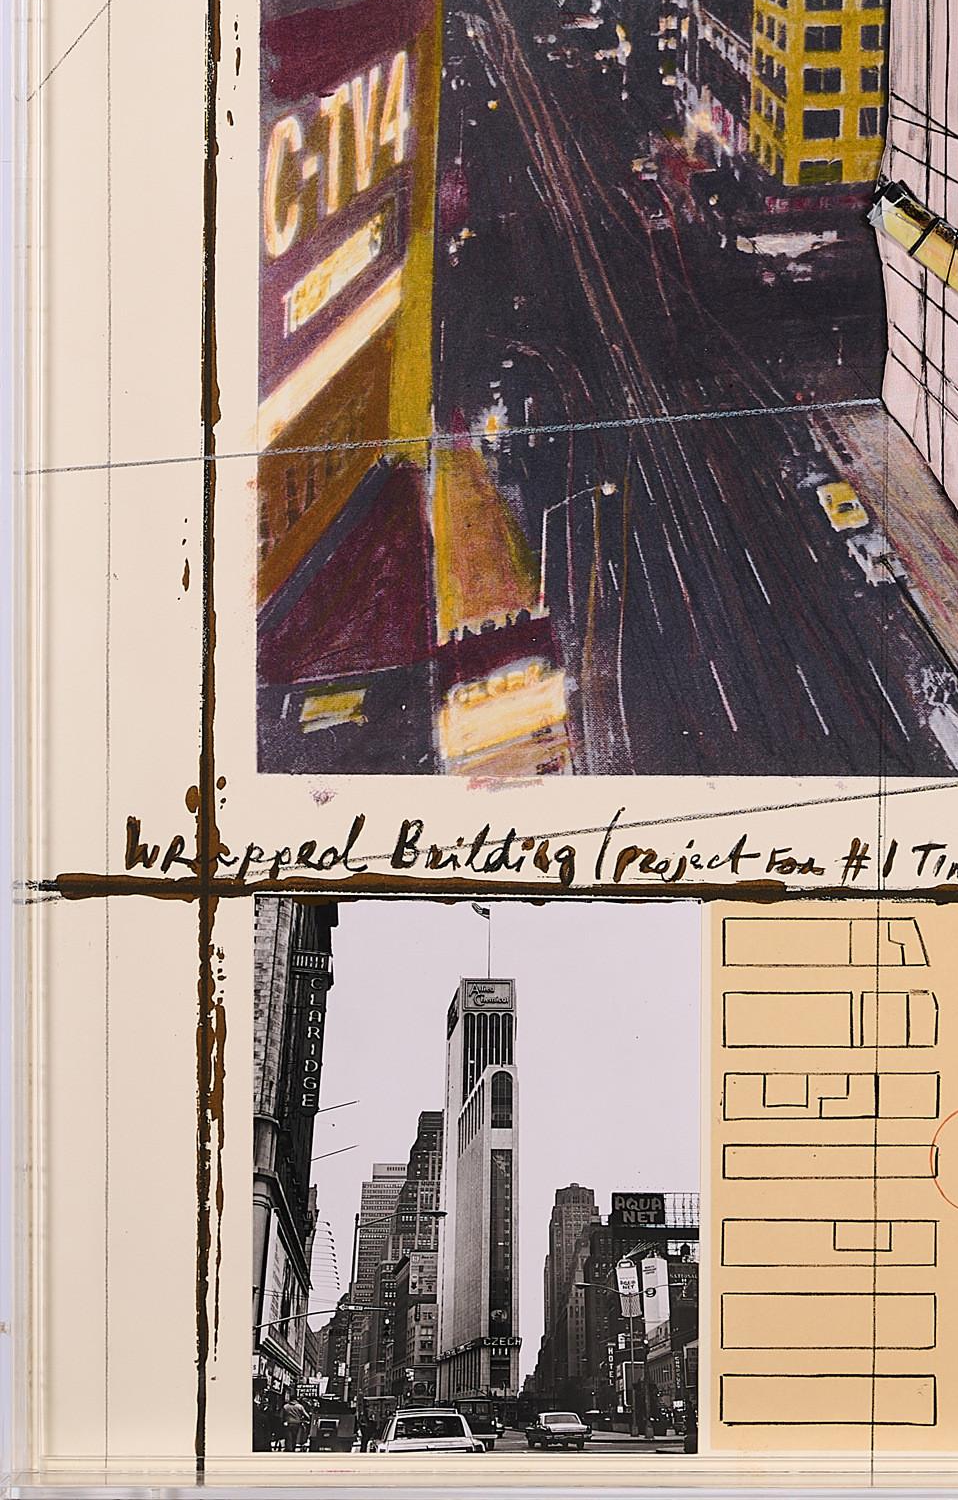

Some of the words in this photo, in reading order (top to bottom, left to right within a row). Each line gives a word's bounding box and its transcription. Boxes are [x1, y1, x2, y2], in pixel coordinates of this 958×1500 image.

[302, 977, 323, 1108] CLARIDGE
[614, 1196, 662, 1211] AQUA
[622, 1211, 658, 1223] NET
